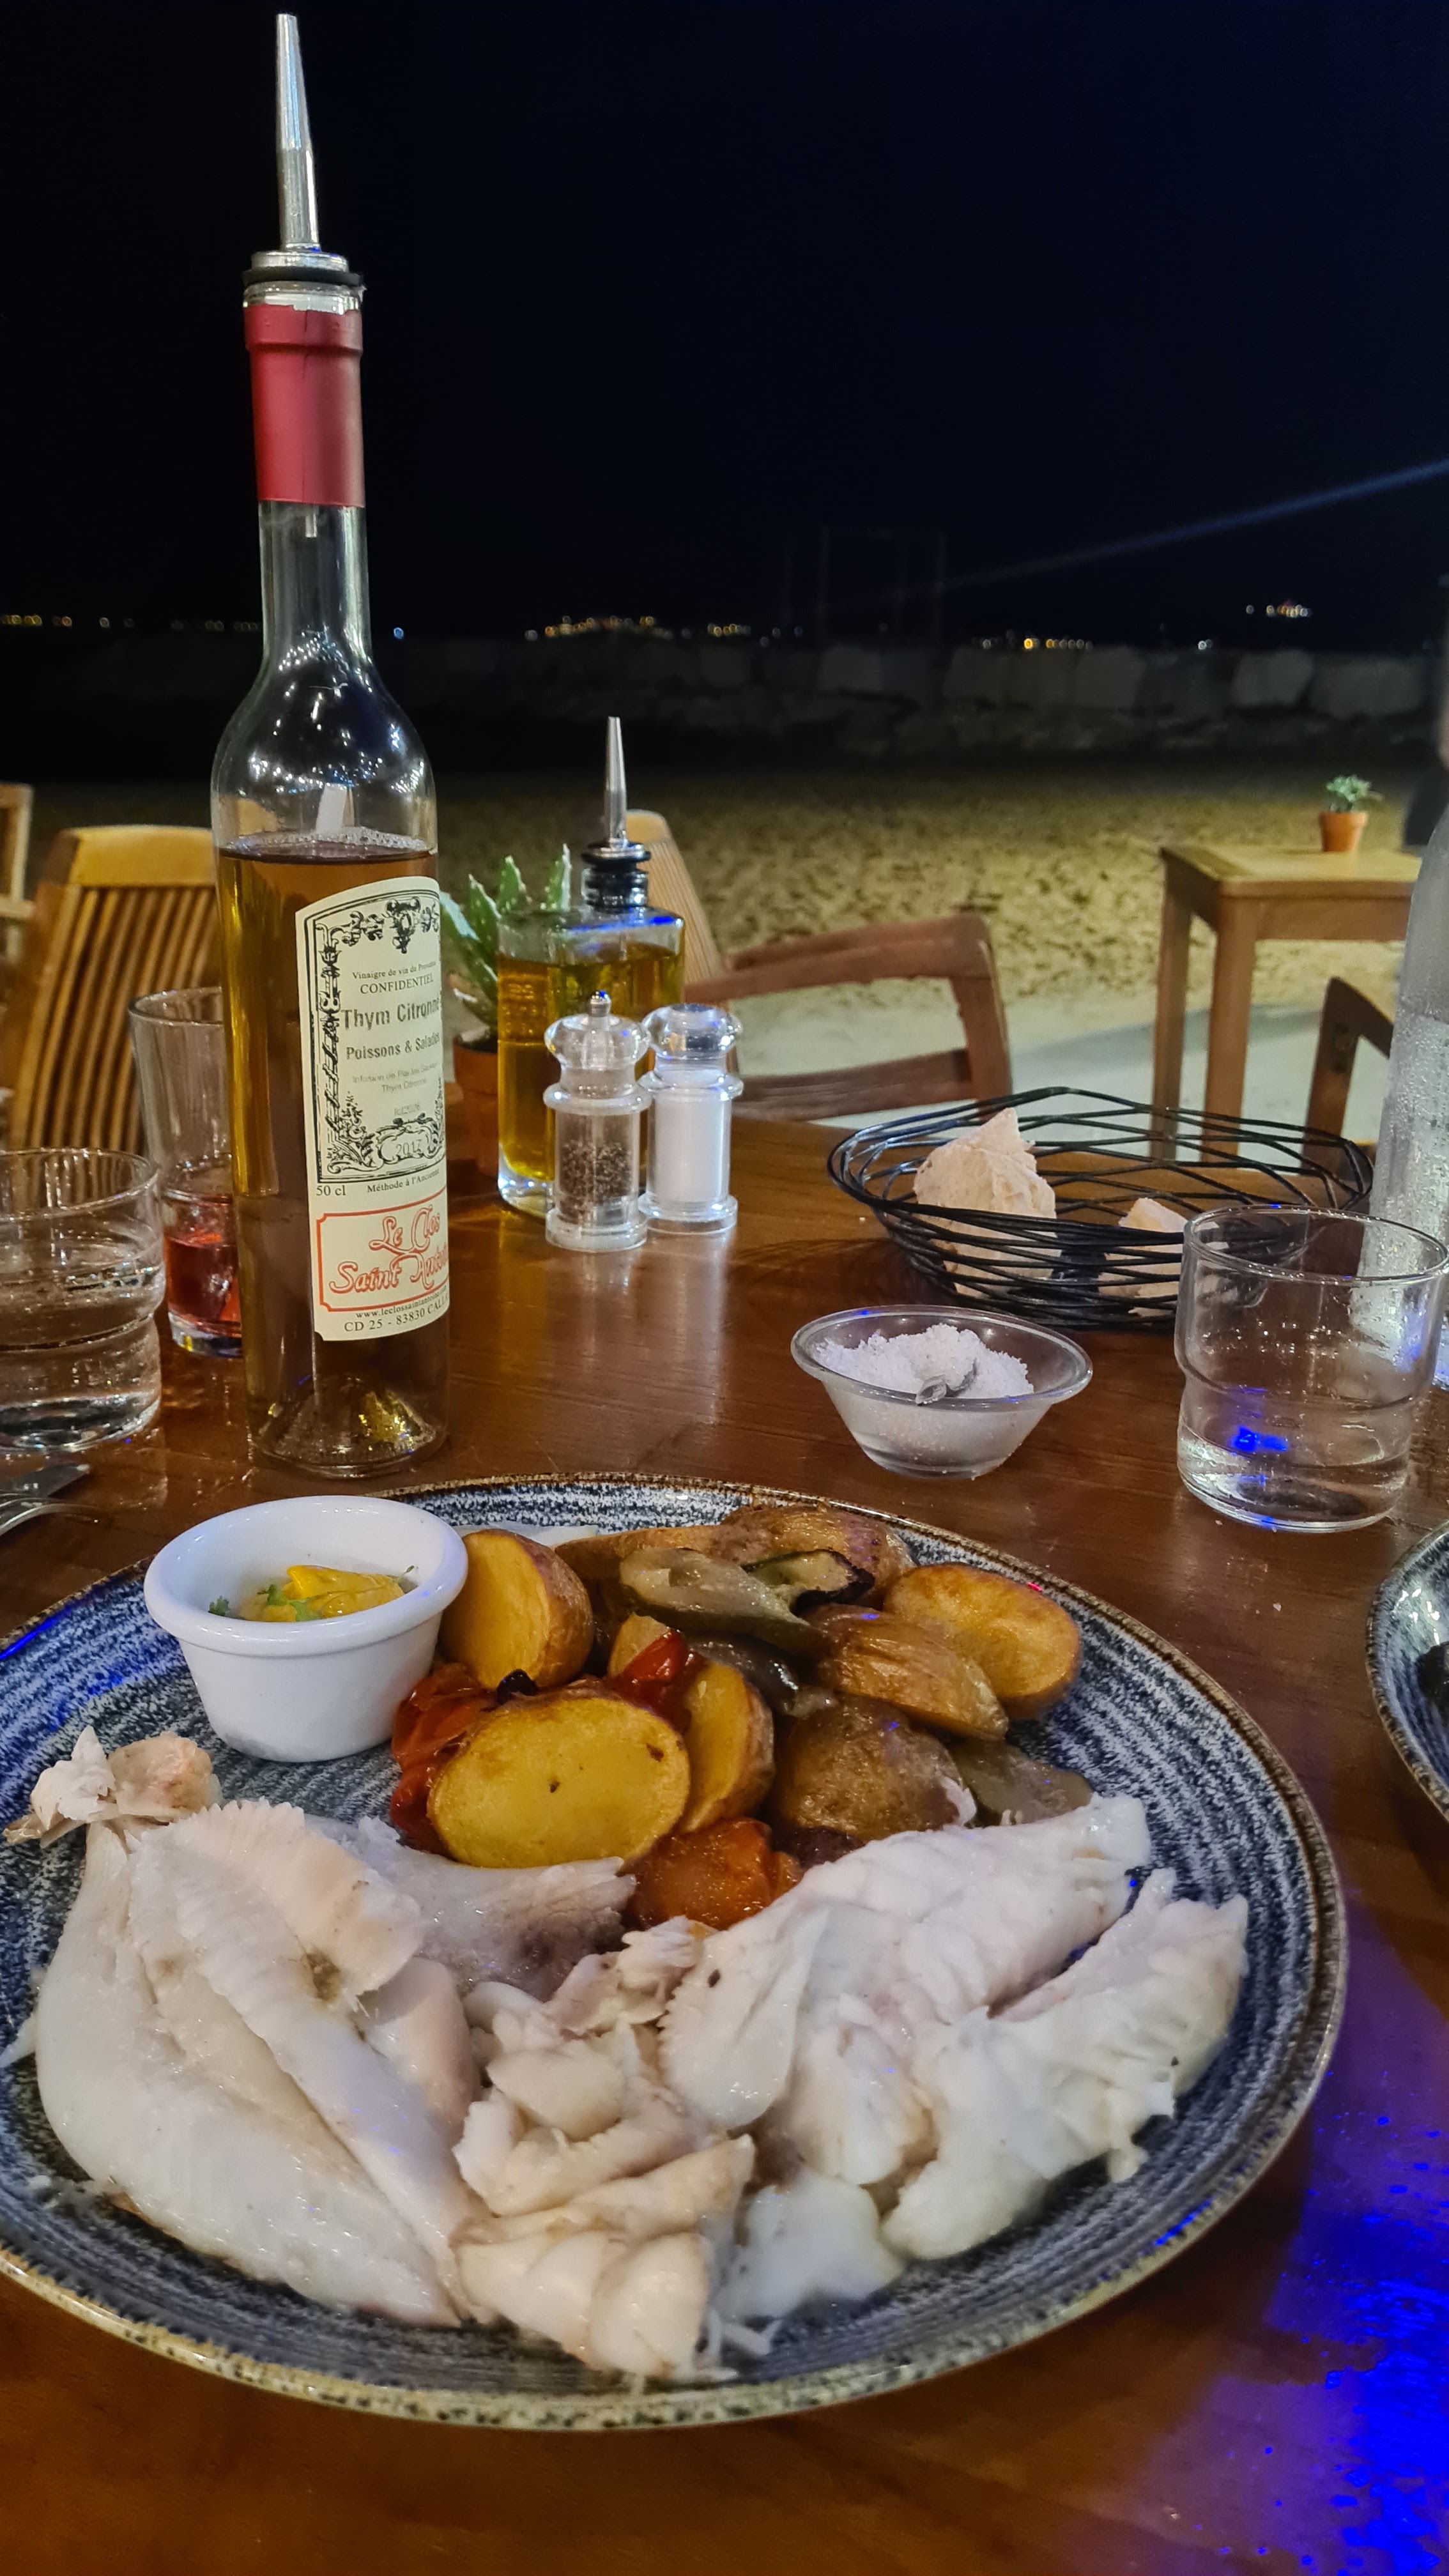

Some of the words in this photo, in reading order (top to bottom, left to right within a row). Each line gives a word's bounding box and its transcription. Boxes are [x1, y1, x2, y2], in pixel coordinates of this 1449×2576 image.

[352, 971, 386, 979] Vinaigre
[388, 968, 397, 976] de
[360, 972, 434, 994] CONFIDENTIEL
[341, 1008, 390, 1031] Thym
[346, 1045, 401, 1060] Poissons
[404, 1039, 412, 1054] &
[316, 1185, 331, 1196] 50
[335, 1184, 346, 1196] cl
[367, 1181, 403, 1193] Méthode
[405, 1177, 410, 1186] à
[369, 1215, 404, 1254] Le
[410, 1204, 441, 1254] Clos
[328, 1257, 402, 1294] Saint
[344, 1321, 365, 1332] CD
[369, 1319, 383, 1330] 25
[395, 1308, 425, 1325] 83830
